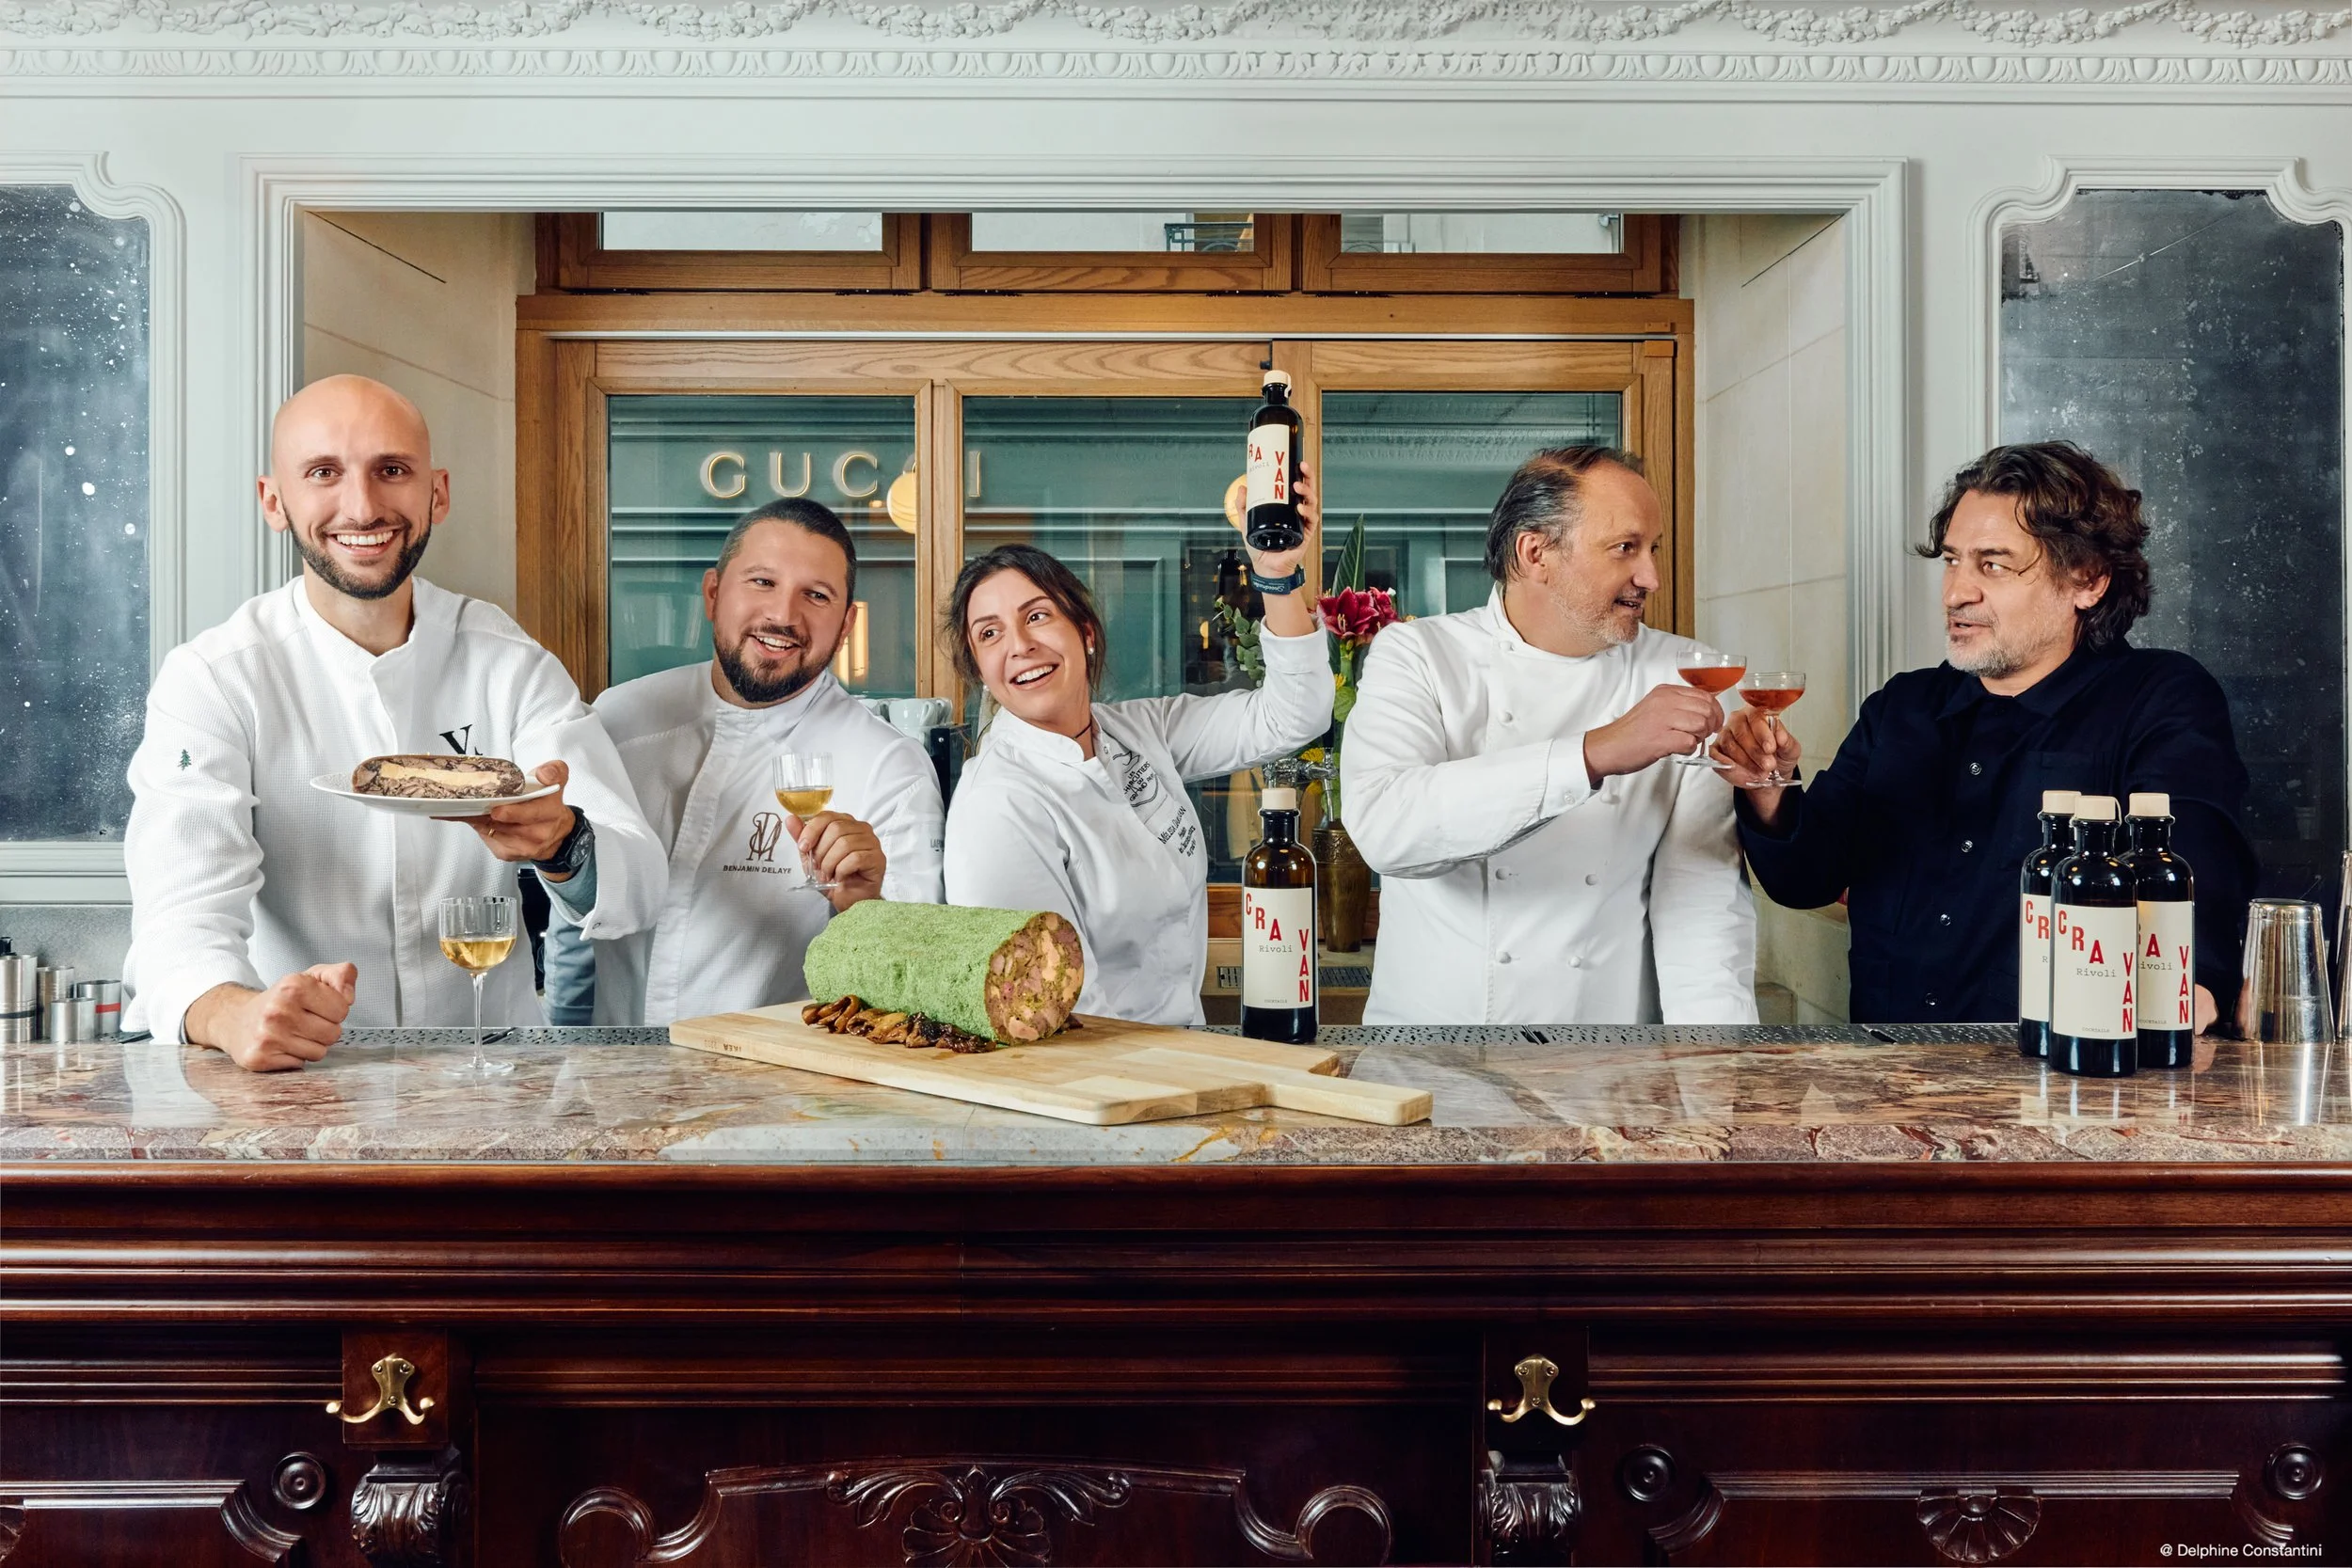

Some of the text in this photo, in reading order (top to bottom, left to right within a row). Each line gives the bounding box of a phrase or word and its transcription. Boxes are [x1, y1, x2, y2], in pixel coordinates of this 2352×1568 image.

[699, 451, 981, 499] GUCI
[723, 864, 759, 873] BENJAMIN
[1259, 944, 1293, 953] Rivoli
[2138, 960, 2173, 971] ivoli
[2076, 968, 2117, 977] Rivoli
